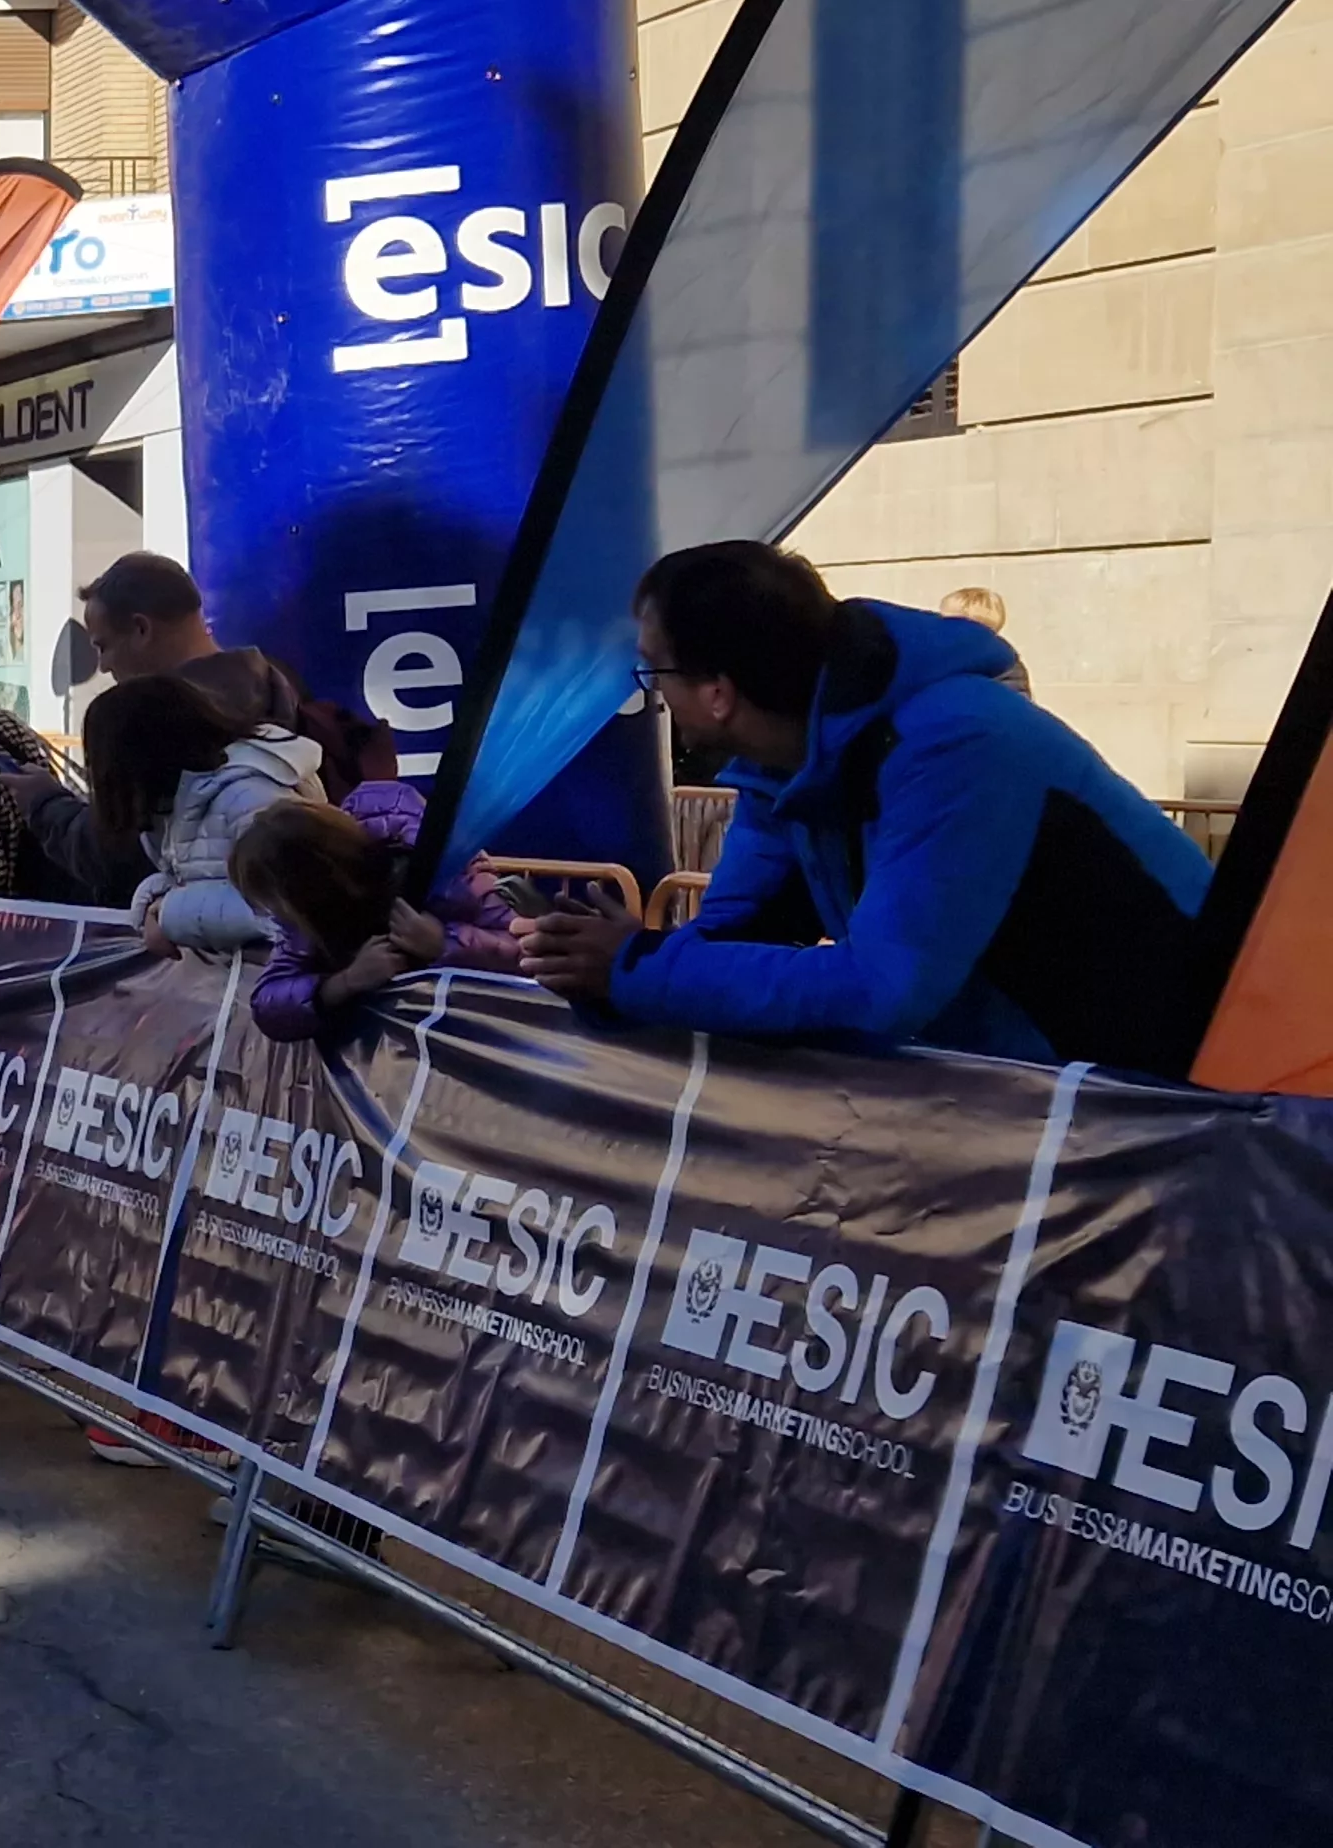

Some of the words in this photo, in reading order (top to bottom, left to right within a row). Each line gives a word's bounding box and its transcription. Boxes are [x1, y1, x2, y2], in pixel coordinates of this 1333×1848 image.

[75, 1073, 180, 1180] ESIC
[240, 1116, 364, 1238] ESIC
[445, 1173, 617, 1317] ESIC
[724, 1244, 951, 1420] ESIC
